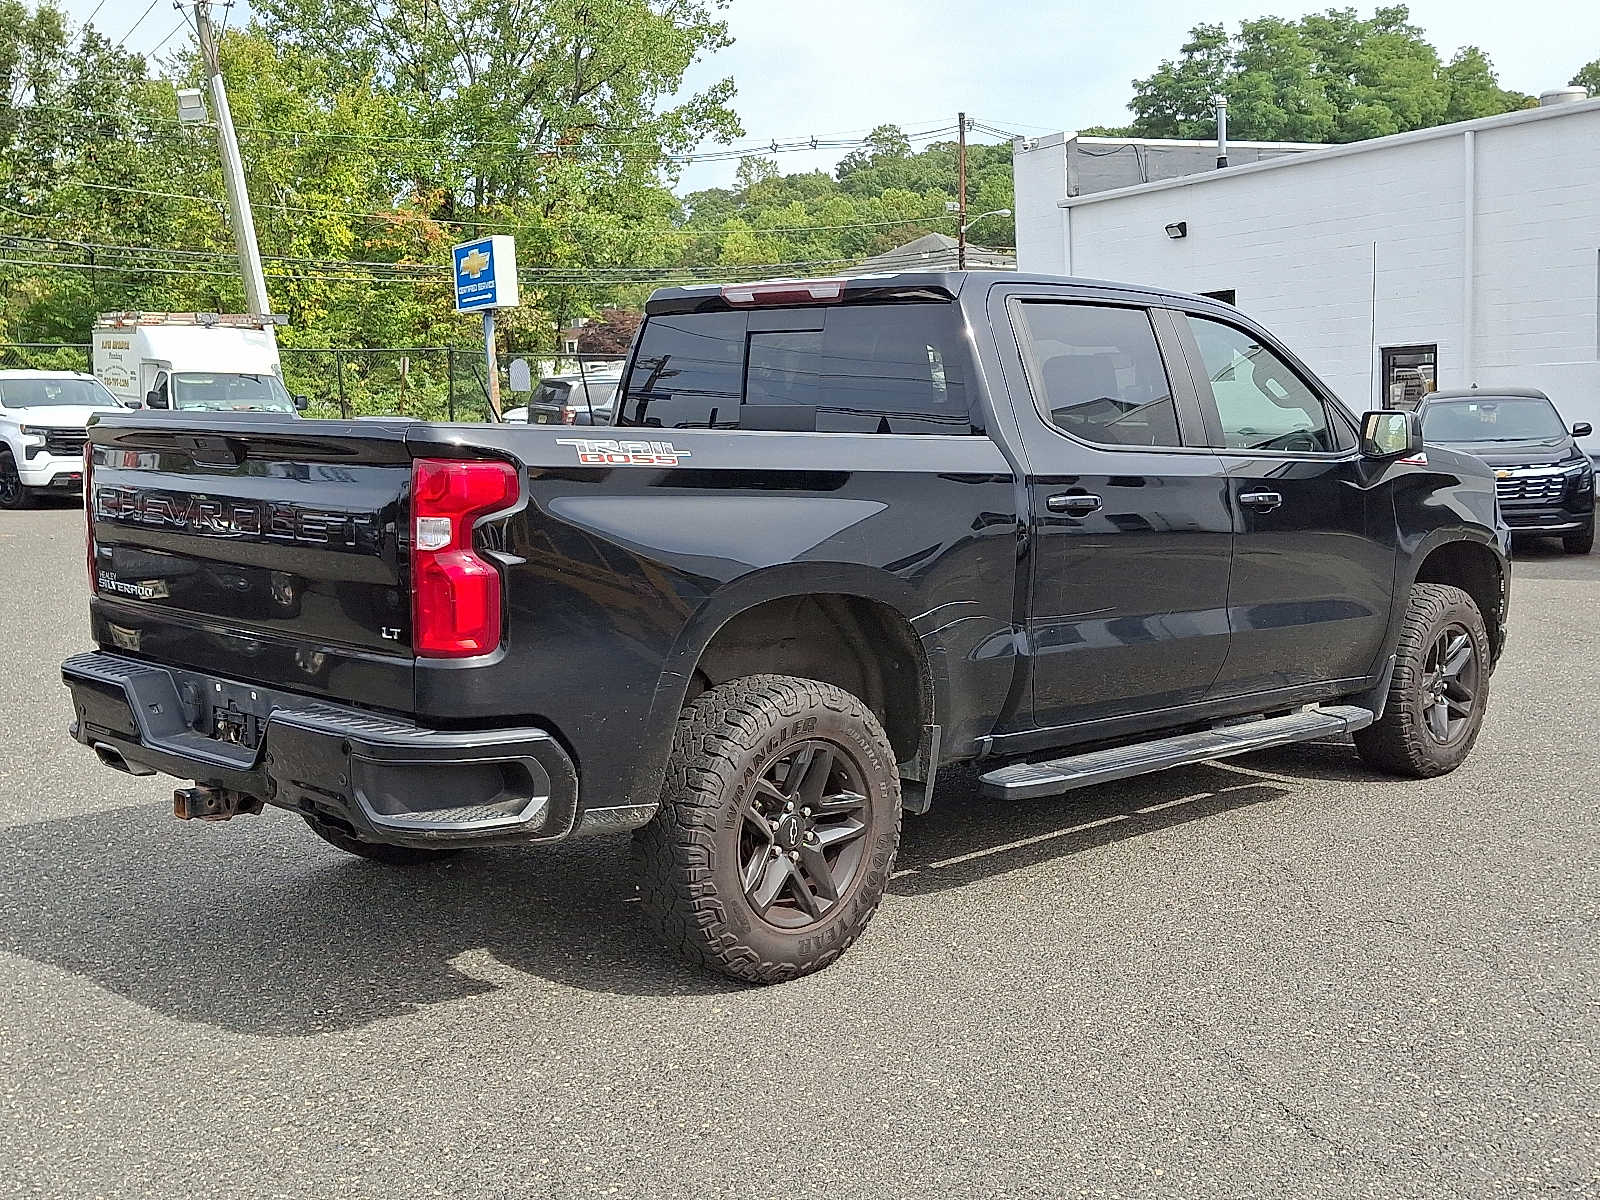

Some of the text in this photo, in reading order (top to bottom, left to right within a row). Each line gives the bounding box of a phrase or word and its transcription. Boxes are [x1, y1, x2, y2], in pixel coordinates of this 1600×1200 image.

[555, 438, 692, 457] TRAIL
[579, 453, 679, 466] BOSS
[96, 483, 373, 546] CHEVROLET
[98, 578, 153, 597] SILVERADO
[381, 626, 401, 639] LT
[723, 716, 818, 830] WRANGLER
